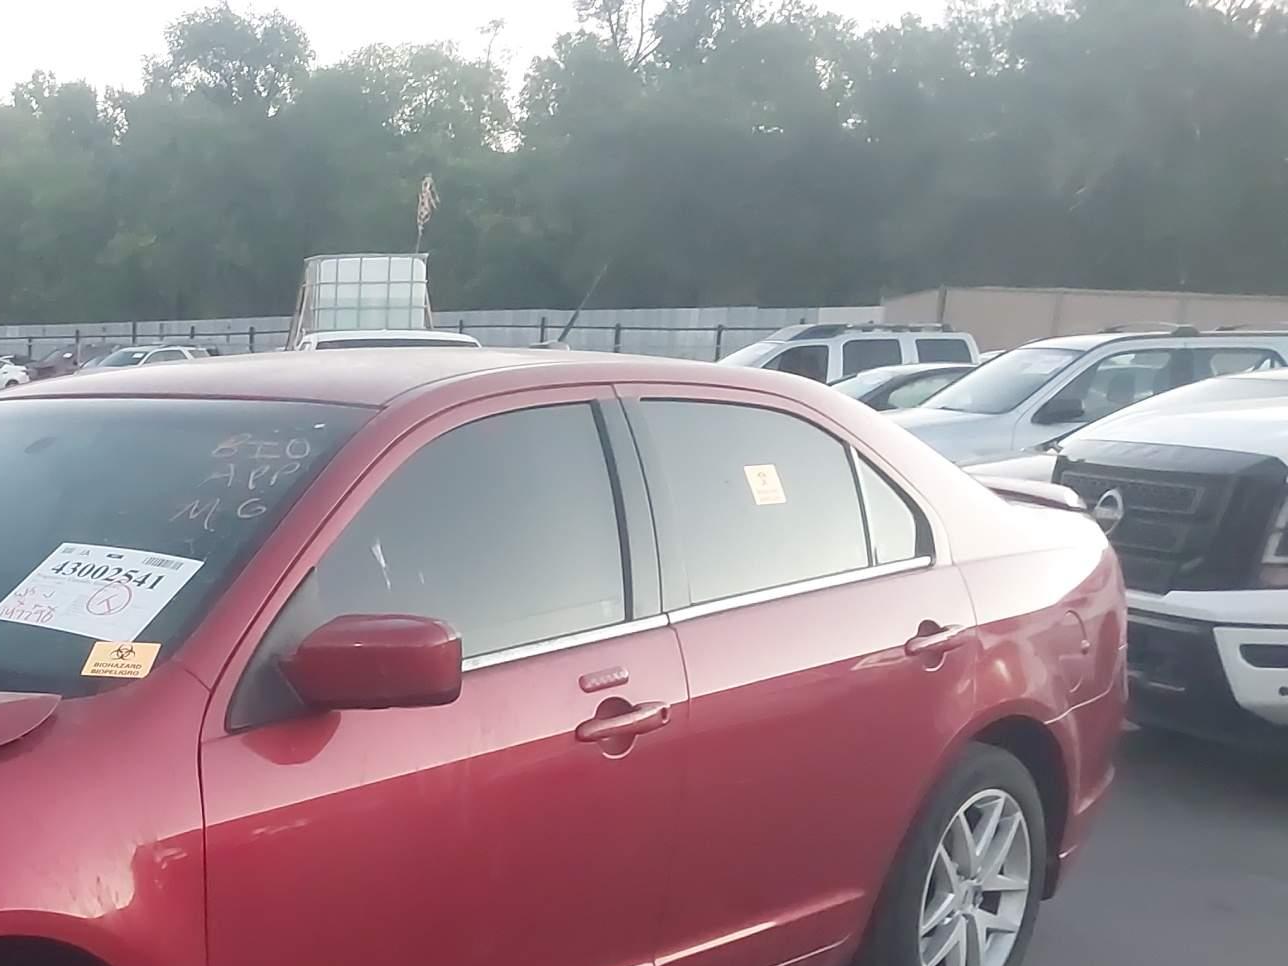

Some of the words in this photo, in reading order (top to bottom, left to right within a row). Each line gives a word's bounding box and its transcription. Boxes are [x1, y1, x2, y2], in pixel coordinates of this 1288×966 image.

[51, 560, 165, 590] 43002541
[93, 662, 143, 670] BIOHAZARD
[90, 668, 140, 676] BIOPELIGRO
